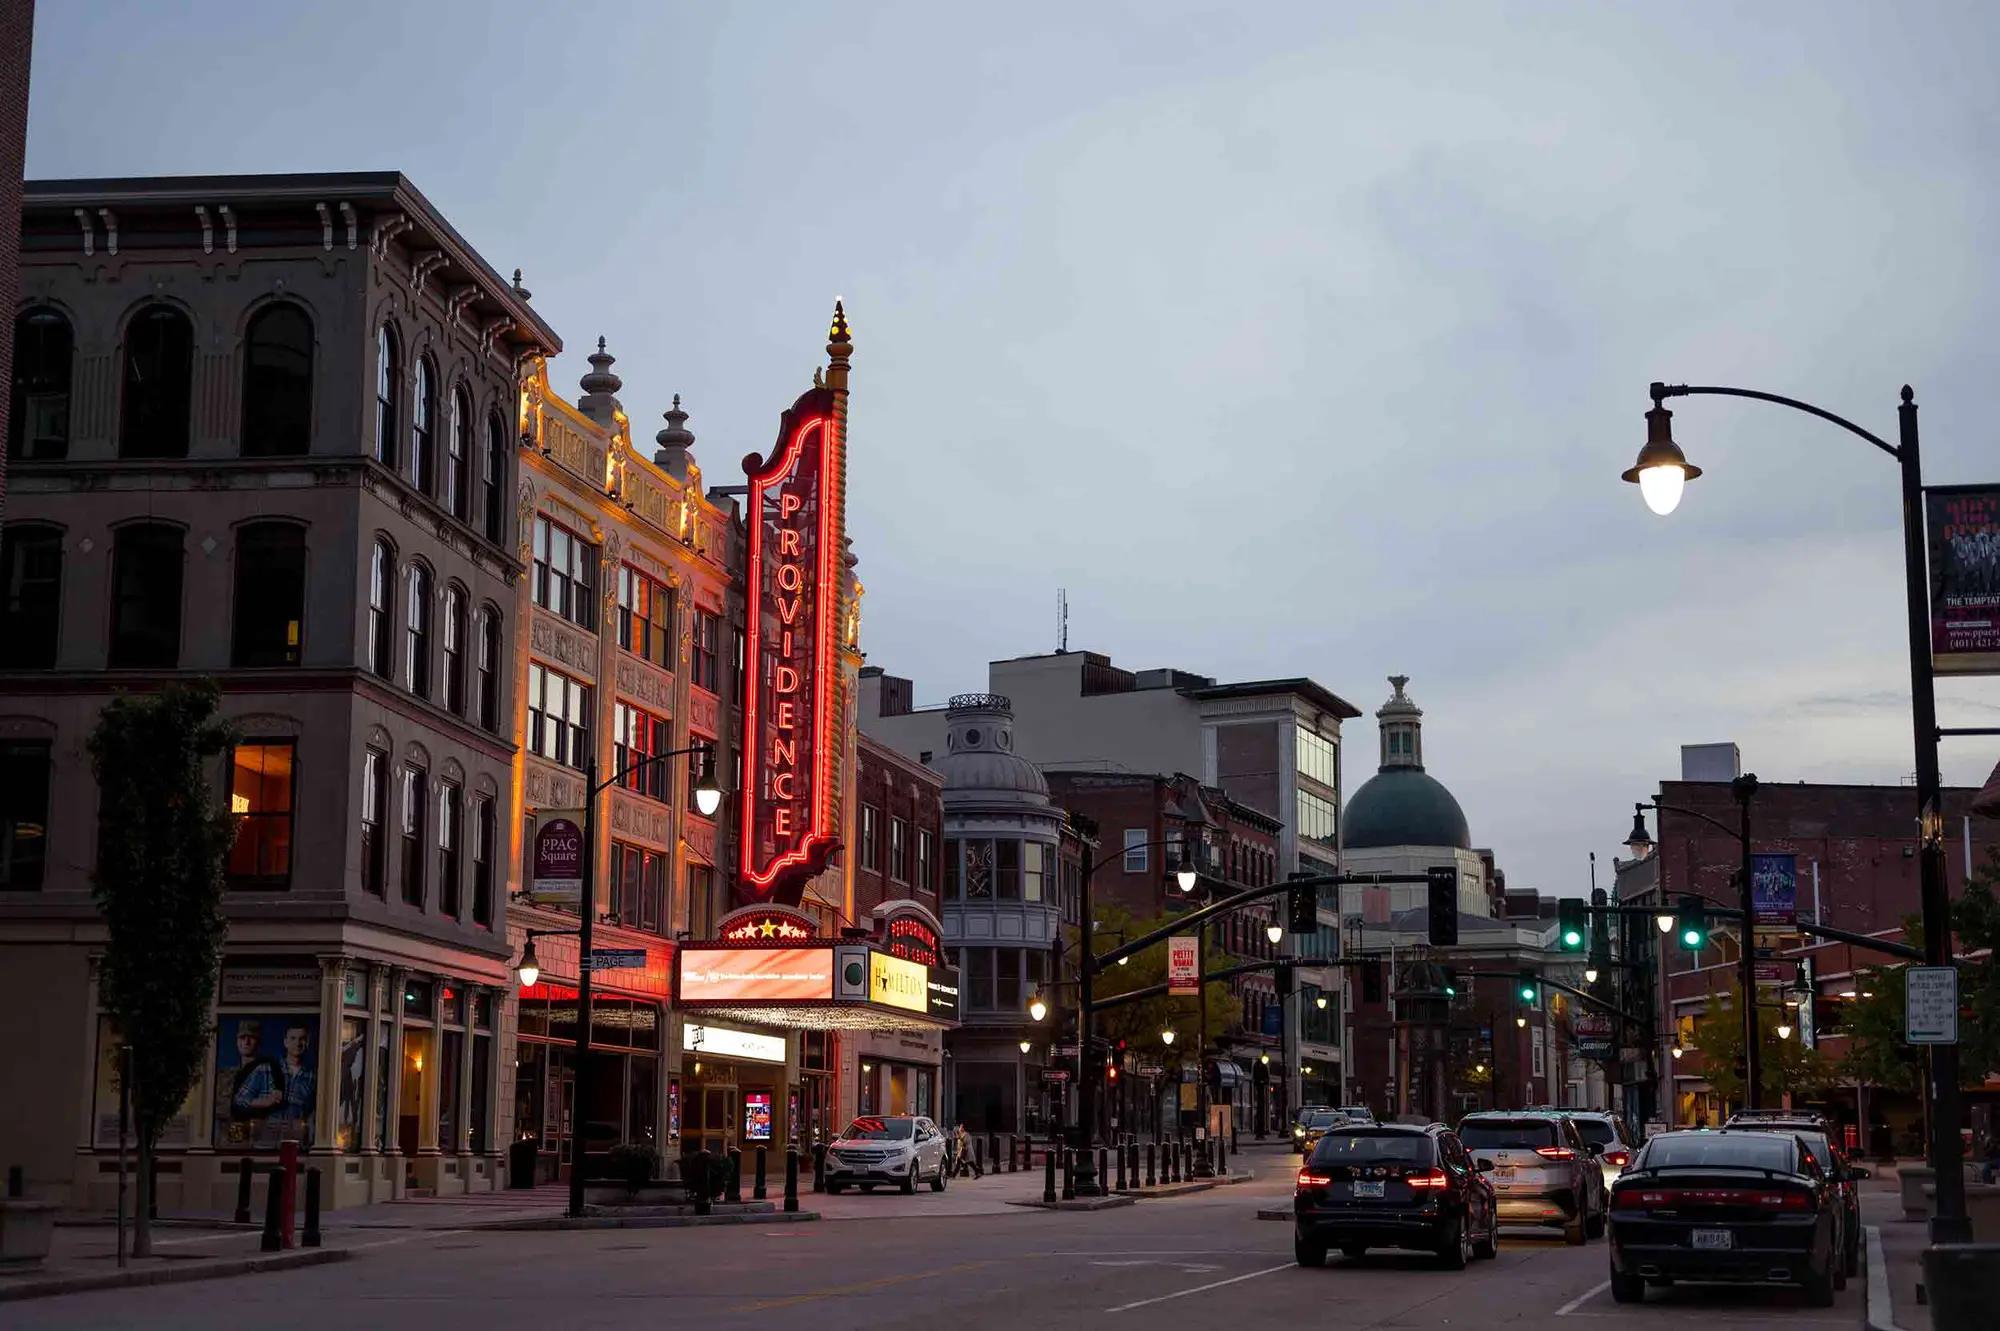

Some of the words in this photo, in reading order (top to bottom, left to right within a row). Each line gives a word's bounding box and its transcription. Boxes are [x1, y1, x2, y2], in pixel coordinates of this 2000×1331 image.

[1946, 597, 1964, 606] THE
[774, 493, 801, 837] PROVIDENCE
[542, 838, 577, 851] PPAC
[540, 850, 577, 864] Square
[596, 956, 625, 967] PAGE
